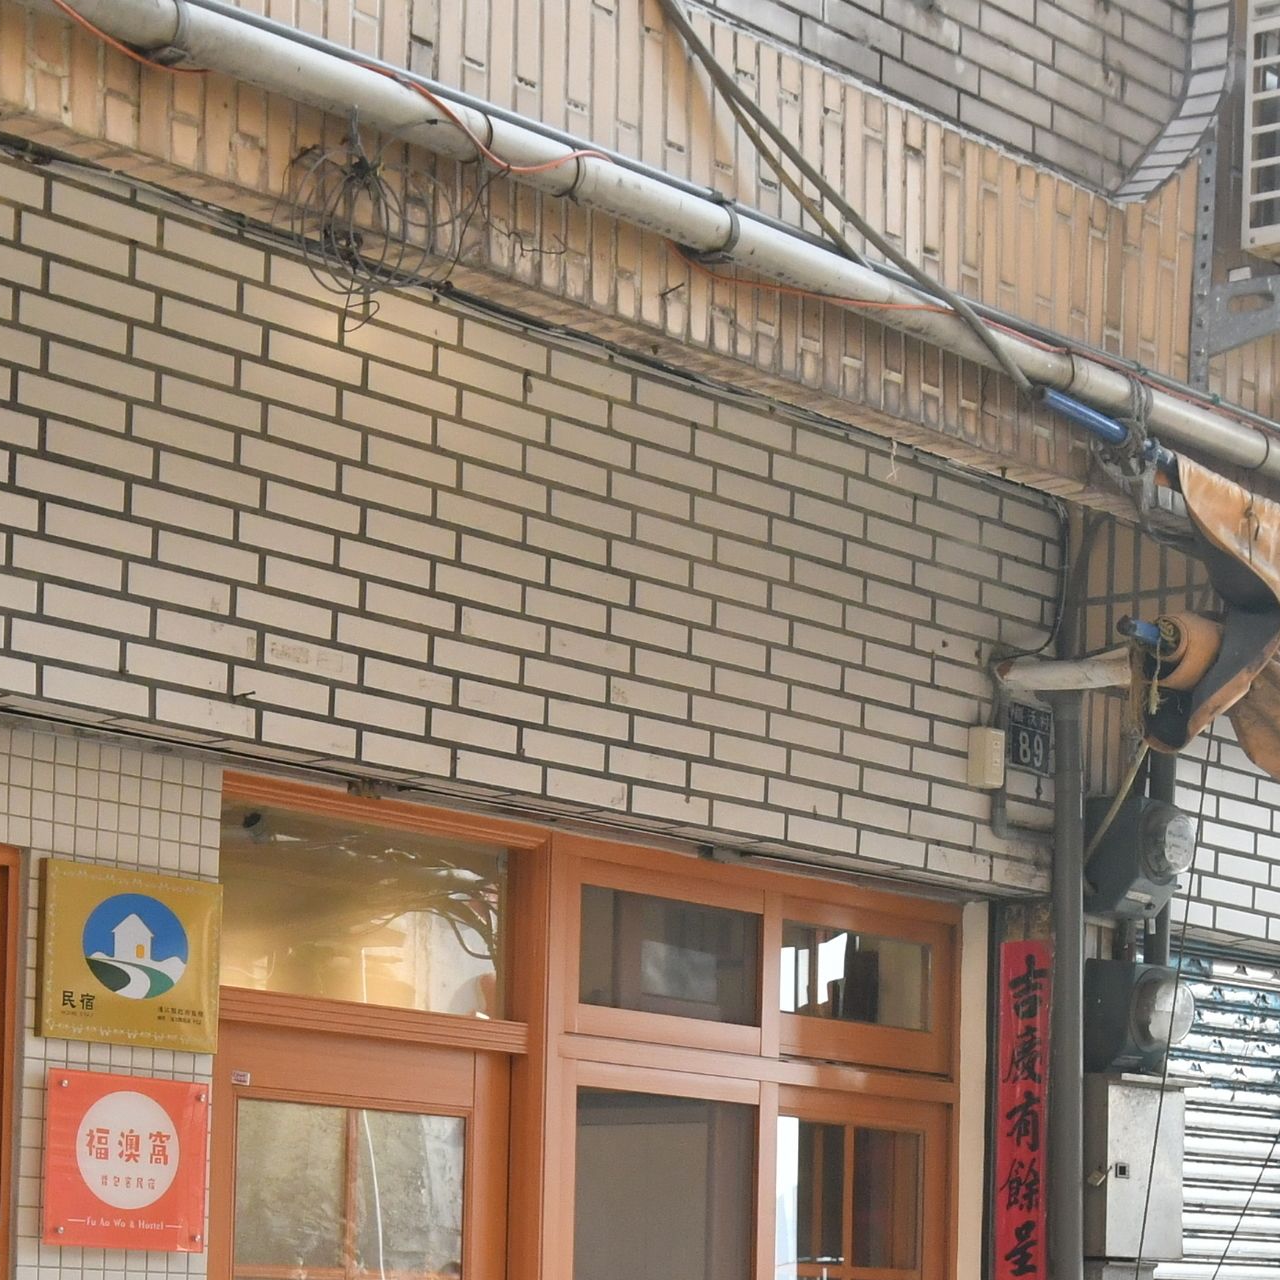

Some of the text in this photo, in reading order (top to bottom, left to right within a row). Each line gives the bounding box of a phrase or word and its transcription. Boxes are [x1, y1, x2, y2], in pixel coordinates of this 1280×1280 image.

[1019, 731, 1044, 768] 89
[61, 990, 96, 1011] 民宿
[85, 1127, 172, 1167] 福澳窩
